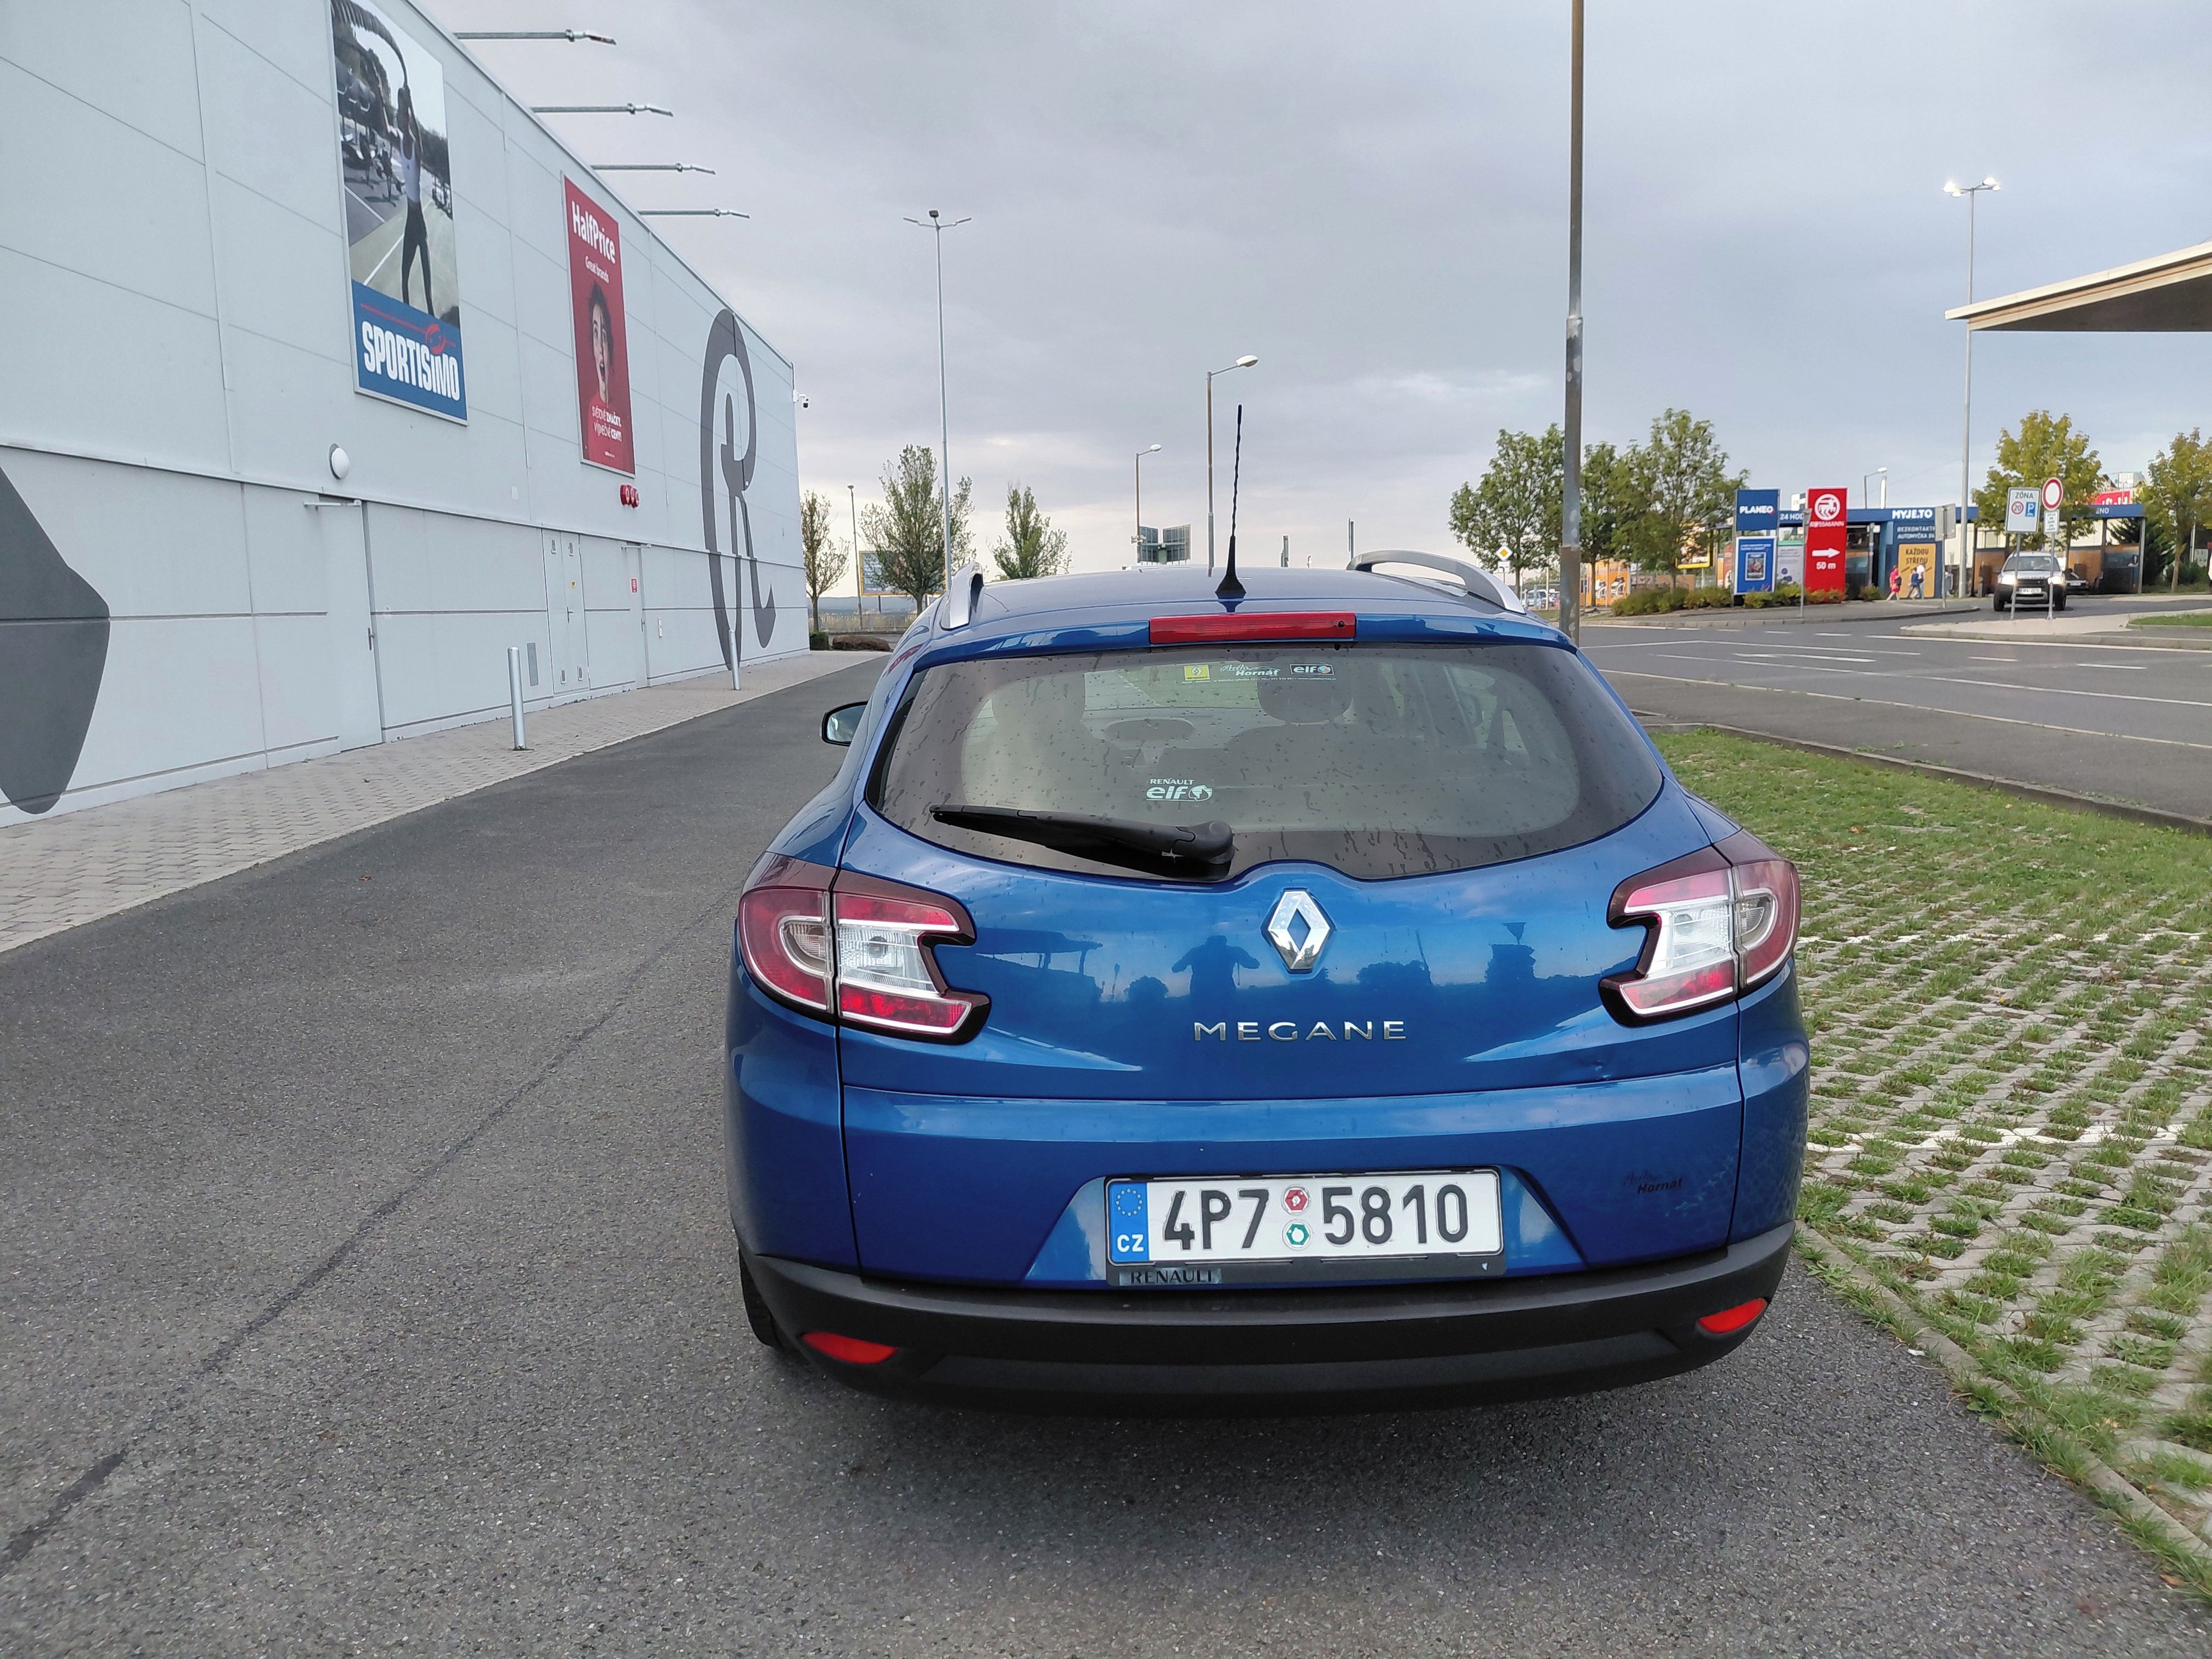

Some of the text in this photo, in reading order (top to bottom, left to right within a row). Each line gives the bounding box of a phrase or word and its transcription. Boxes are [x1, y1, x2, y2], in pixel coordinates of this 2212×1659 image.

[571, 200, 616, 264] HalfPrice
[362, 320, 460, 401] SPORTISIMO
[1739, 505, 1774, 515] PLANEO
[1892, 509, 1933, 519] MYJE.TO
[1146, 786, 1189, 799] elf
[1193, 1020, 1407, 1041] MEGANE
[1163, 1184, 1469, 1250] 4P7 5810
[1117, 1233, 1144, 1252] CZ
[1130, 1269, 1212, 1284] RENAULT
